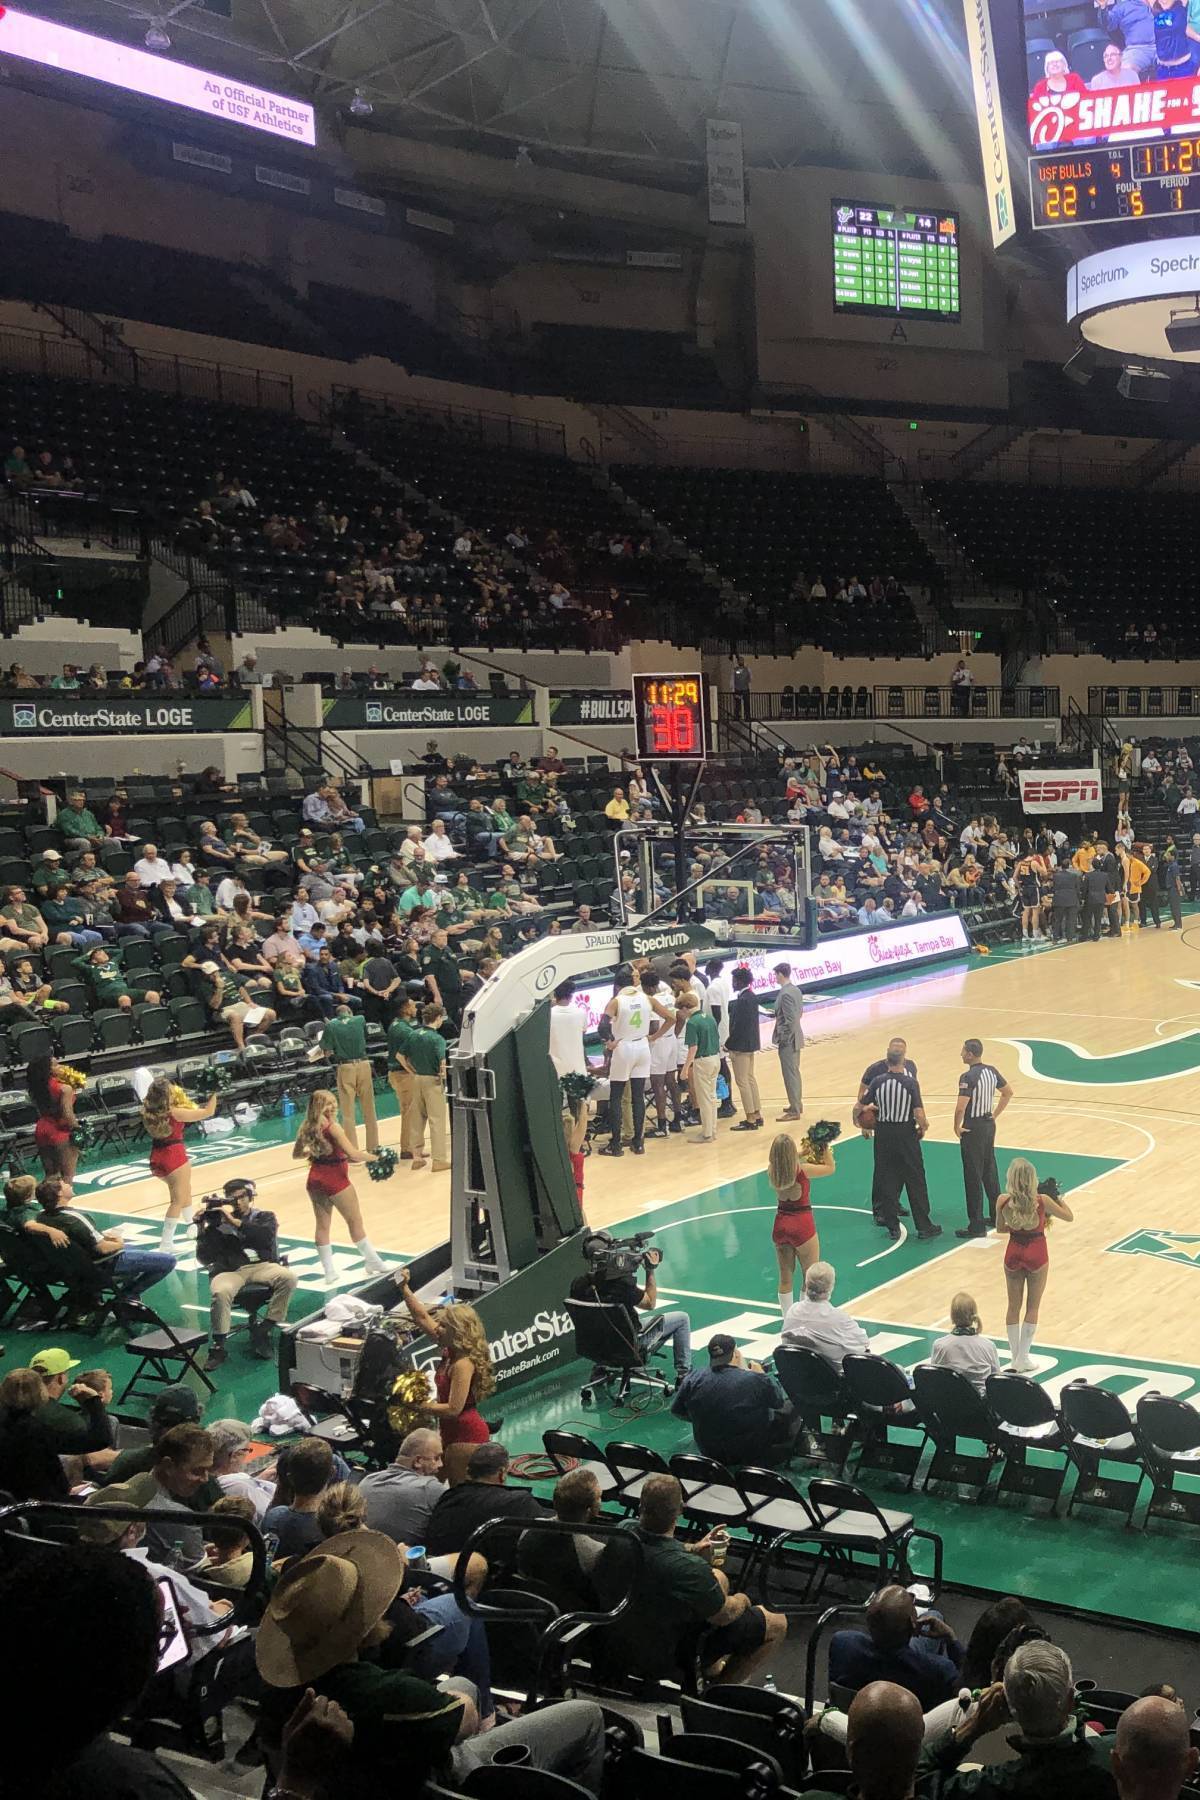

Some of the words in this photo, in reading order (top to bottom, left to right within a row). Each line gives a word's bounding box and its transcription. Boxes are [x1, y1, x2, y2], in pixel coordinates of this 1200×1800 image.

[204, 80, 221, 95] An
[224, 86, 266, 109] Official
[268, 100, 310, 122] Partner
[212, 99, 225, 110] of
[228, 101, 251, 118] USF
[253, 111, 304, 135] Athletics
[1039, 166, 1058, 181] USF
[1059, 162, 1092, 180] BULLS
[1111, 163, 1121, 178] 4
[1116, 182, 1142, 194] FOULS
[1160, 177, 1190, 189] PERIOD
[1046, 184, 1077, 218] 22
[1131, 192, 1144, 216] 5
[1081, 266, 1125, 293] Spectrum
[648, 681, 699, 706] 11:29
[38, 708, 142, 727] CenterState
[146, 708, 194, 726] LOGE
[383, 706, 455, 722] CenterState
[458, 706, 490, 722] LOGE
[653, 705, 695, 752] 30
[1023, 780, 1098, 802] ESPN
[585, 934, 621, 949] SPALDIN
[633, 932, 686, 955] Spectrum
[914, 939, 939, 954] Tampa
[939, 935, 956, 950] Bay
[794, 965, 824, 981] Tampa
[825, 959, 842, 974] Bay
[629, 1010, 642, 1029] 4
[489, 1310, 576, 1364] nterSta
[493, 1347, 560, 1384] rStateBank.com
